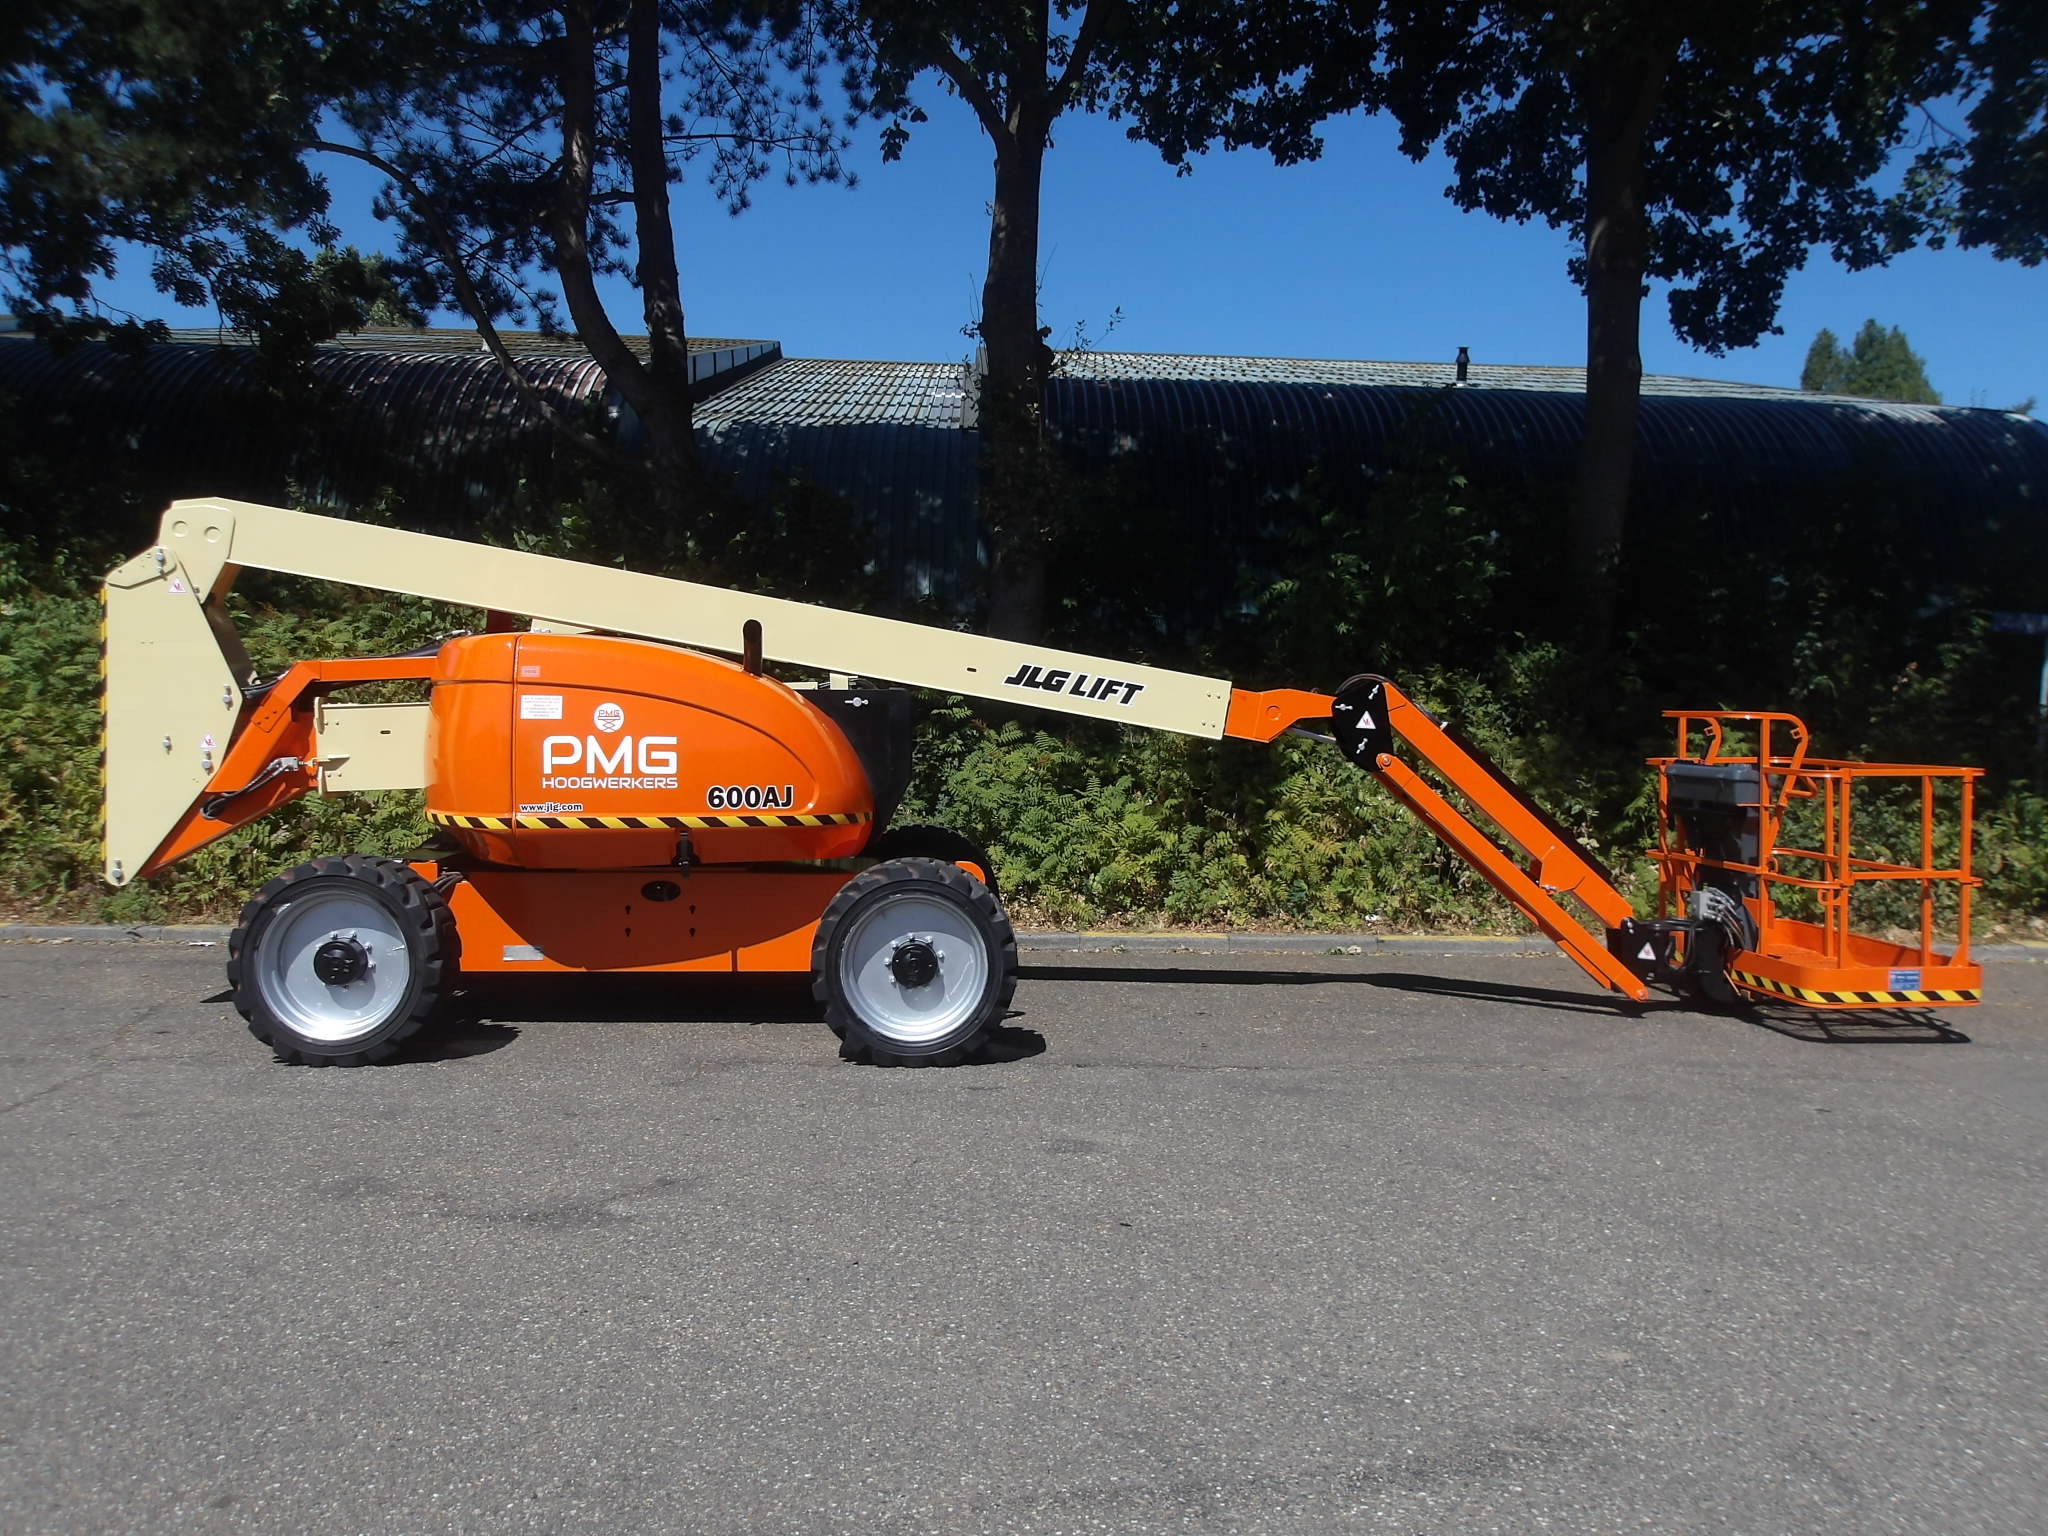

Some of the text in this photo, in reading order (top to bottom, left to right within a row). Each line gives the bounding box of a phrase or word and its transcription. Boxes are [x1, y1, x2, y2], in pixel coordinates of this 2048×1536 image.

[1003, 664, 1145, 705] JLG LIFT
[599, 709, 620, 717] PMG
[543, 735, 678, 775] PMG
[542, 777, 679, 789] HOOGWERKERS
[707, 785, 793, 809] 600AJ
[520, 802, 583, 813] www.jlg.com
